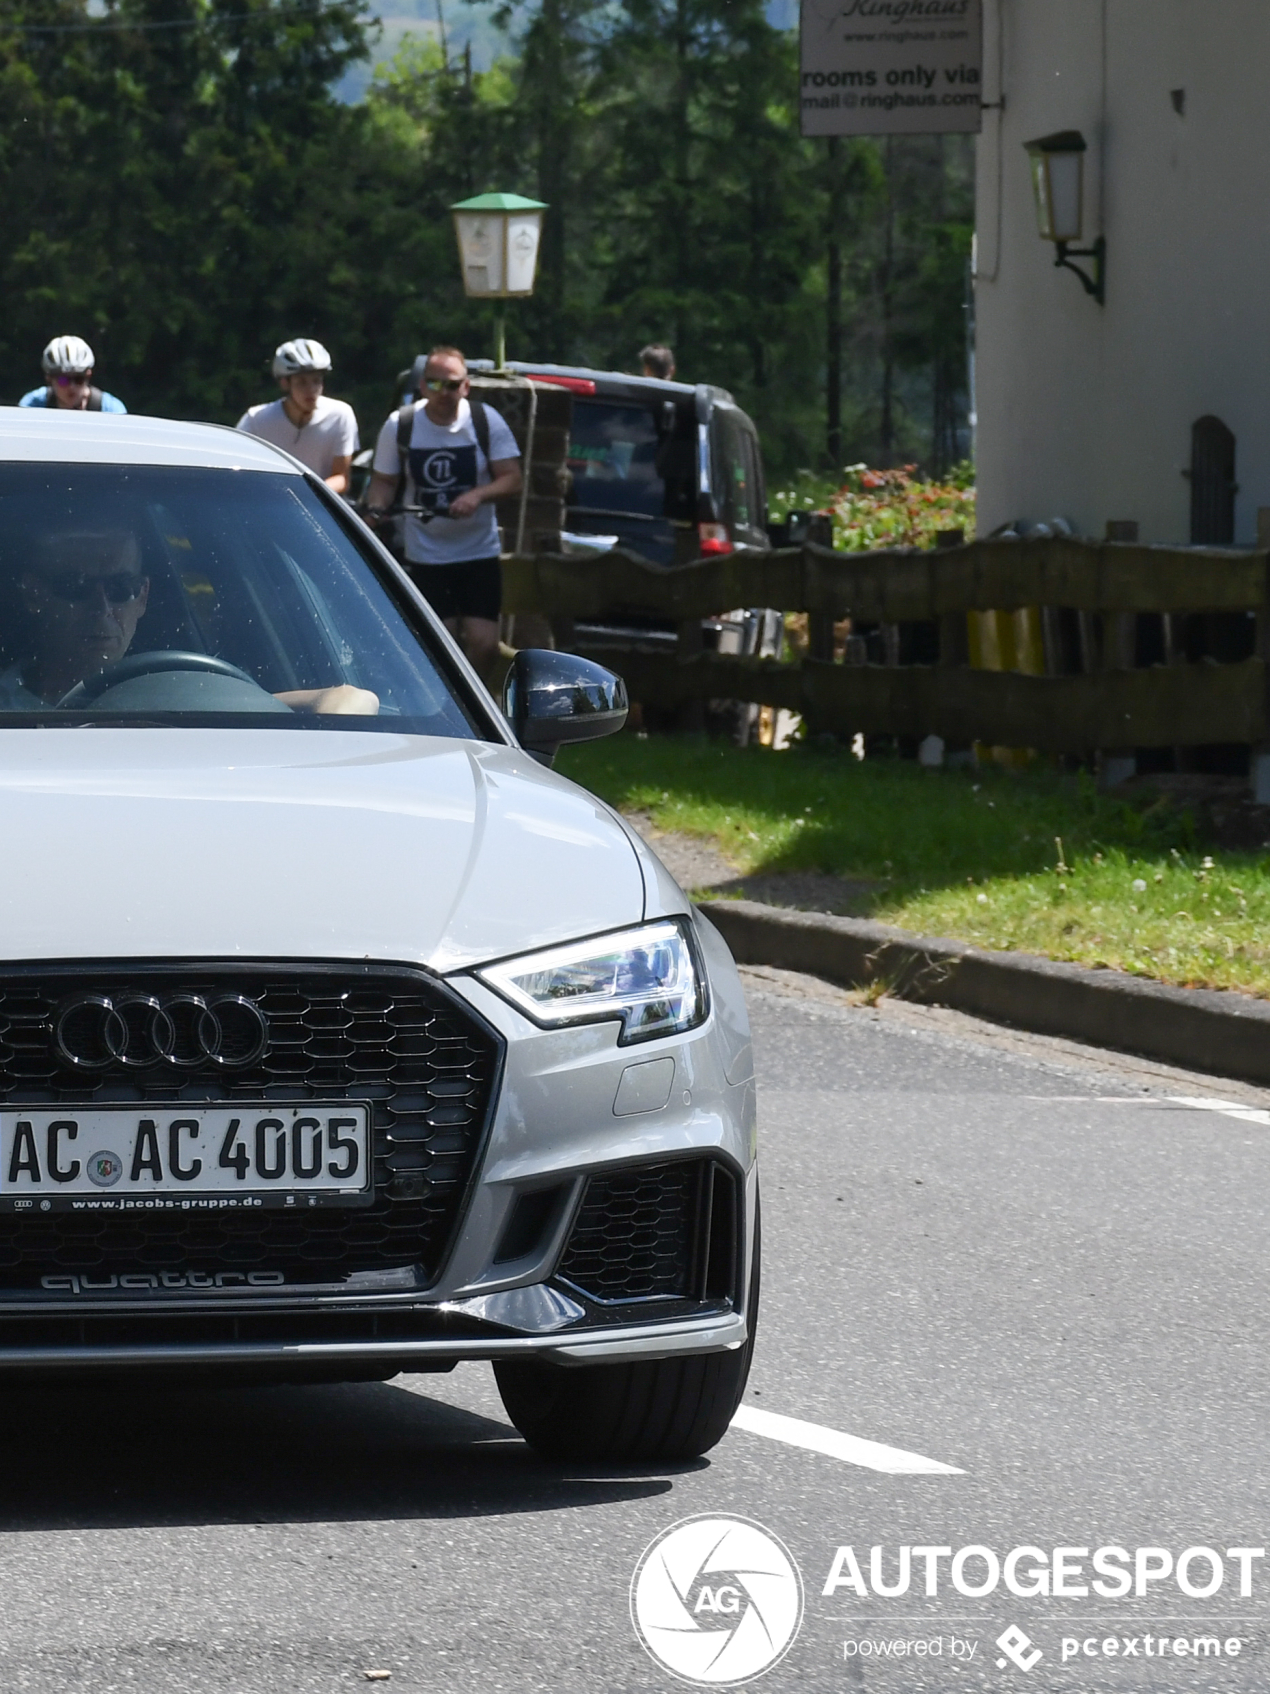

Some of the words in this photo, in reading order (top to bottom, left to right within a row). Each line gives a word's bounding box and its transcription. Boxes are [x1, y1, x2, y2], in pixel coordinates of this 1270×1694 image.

[802, 69, 877, 87] rooms
[885, 64, 937, 88] only
[944, 63, 979, 84] via
[8, 1120, 81, 1183] AC
[130, 1119, 202, 1182] AC
[218, 1117, 358, 1180] 4005
[72, 1196, 263, 1210] www.jacobs-gruppe.de
[40, 1270, 285, 1294] quattro
